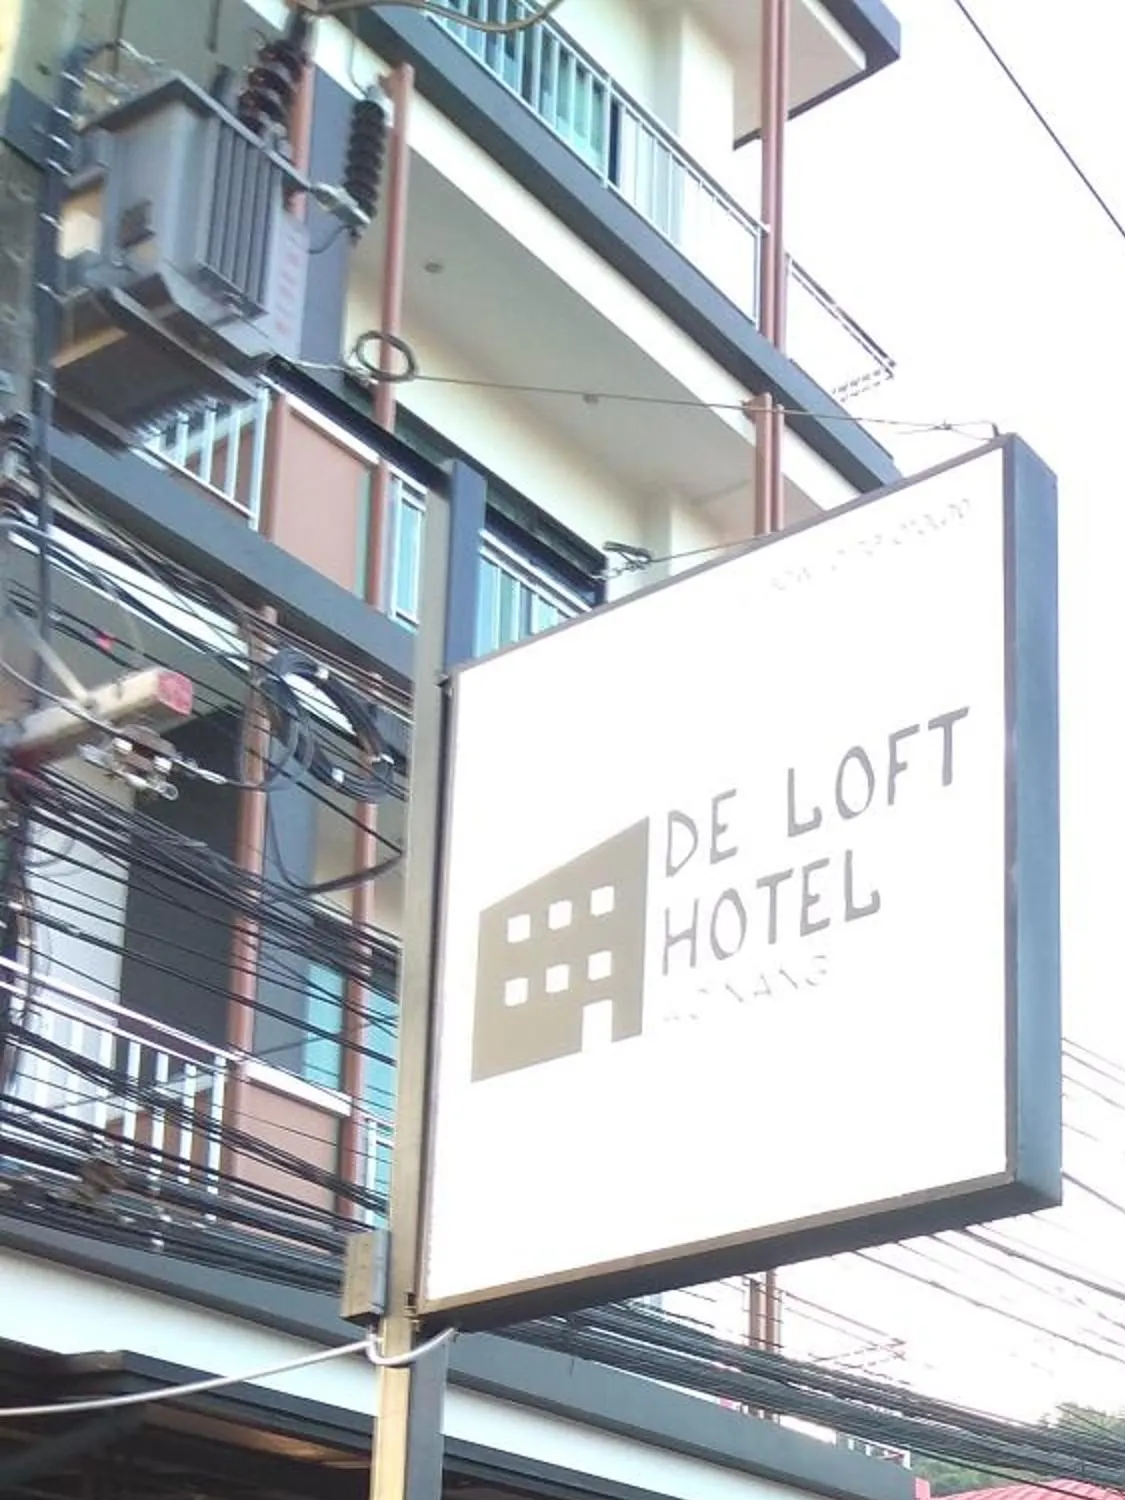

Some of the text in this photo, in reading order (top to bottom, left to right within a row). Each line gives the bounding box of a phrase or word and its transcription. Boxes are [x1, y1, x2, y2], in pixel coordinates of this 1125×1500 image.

[665, 705, 970, 877] DE LOFT
[661, 849, 882, 976] HOTEL
